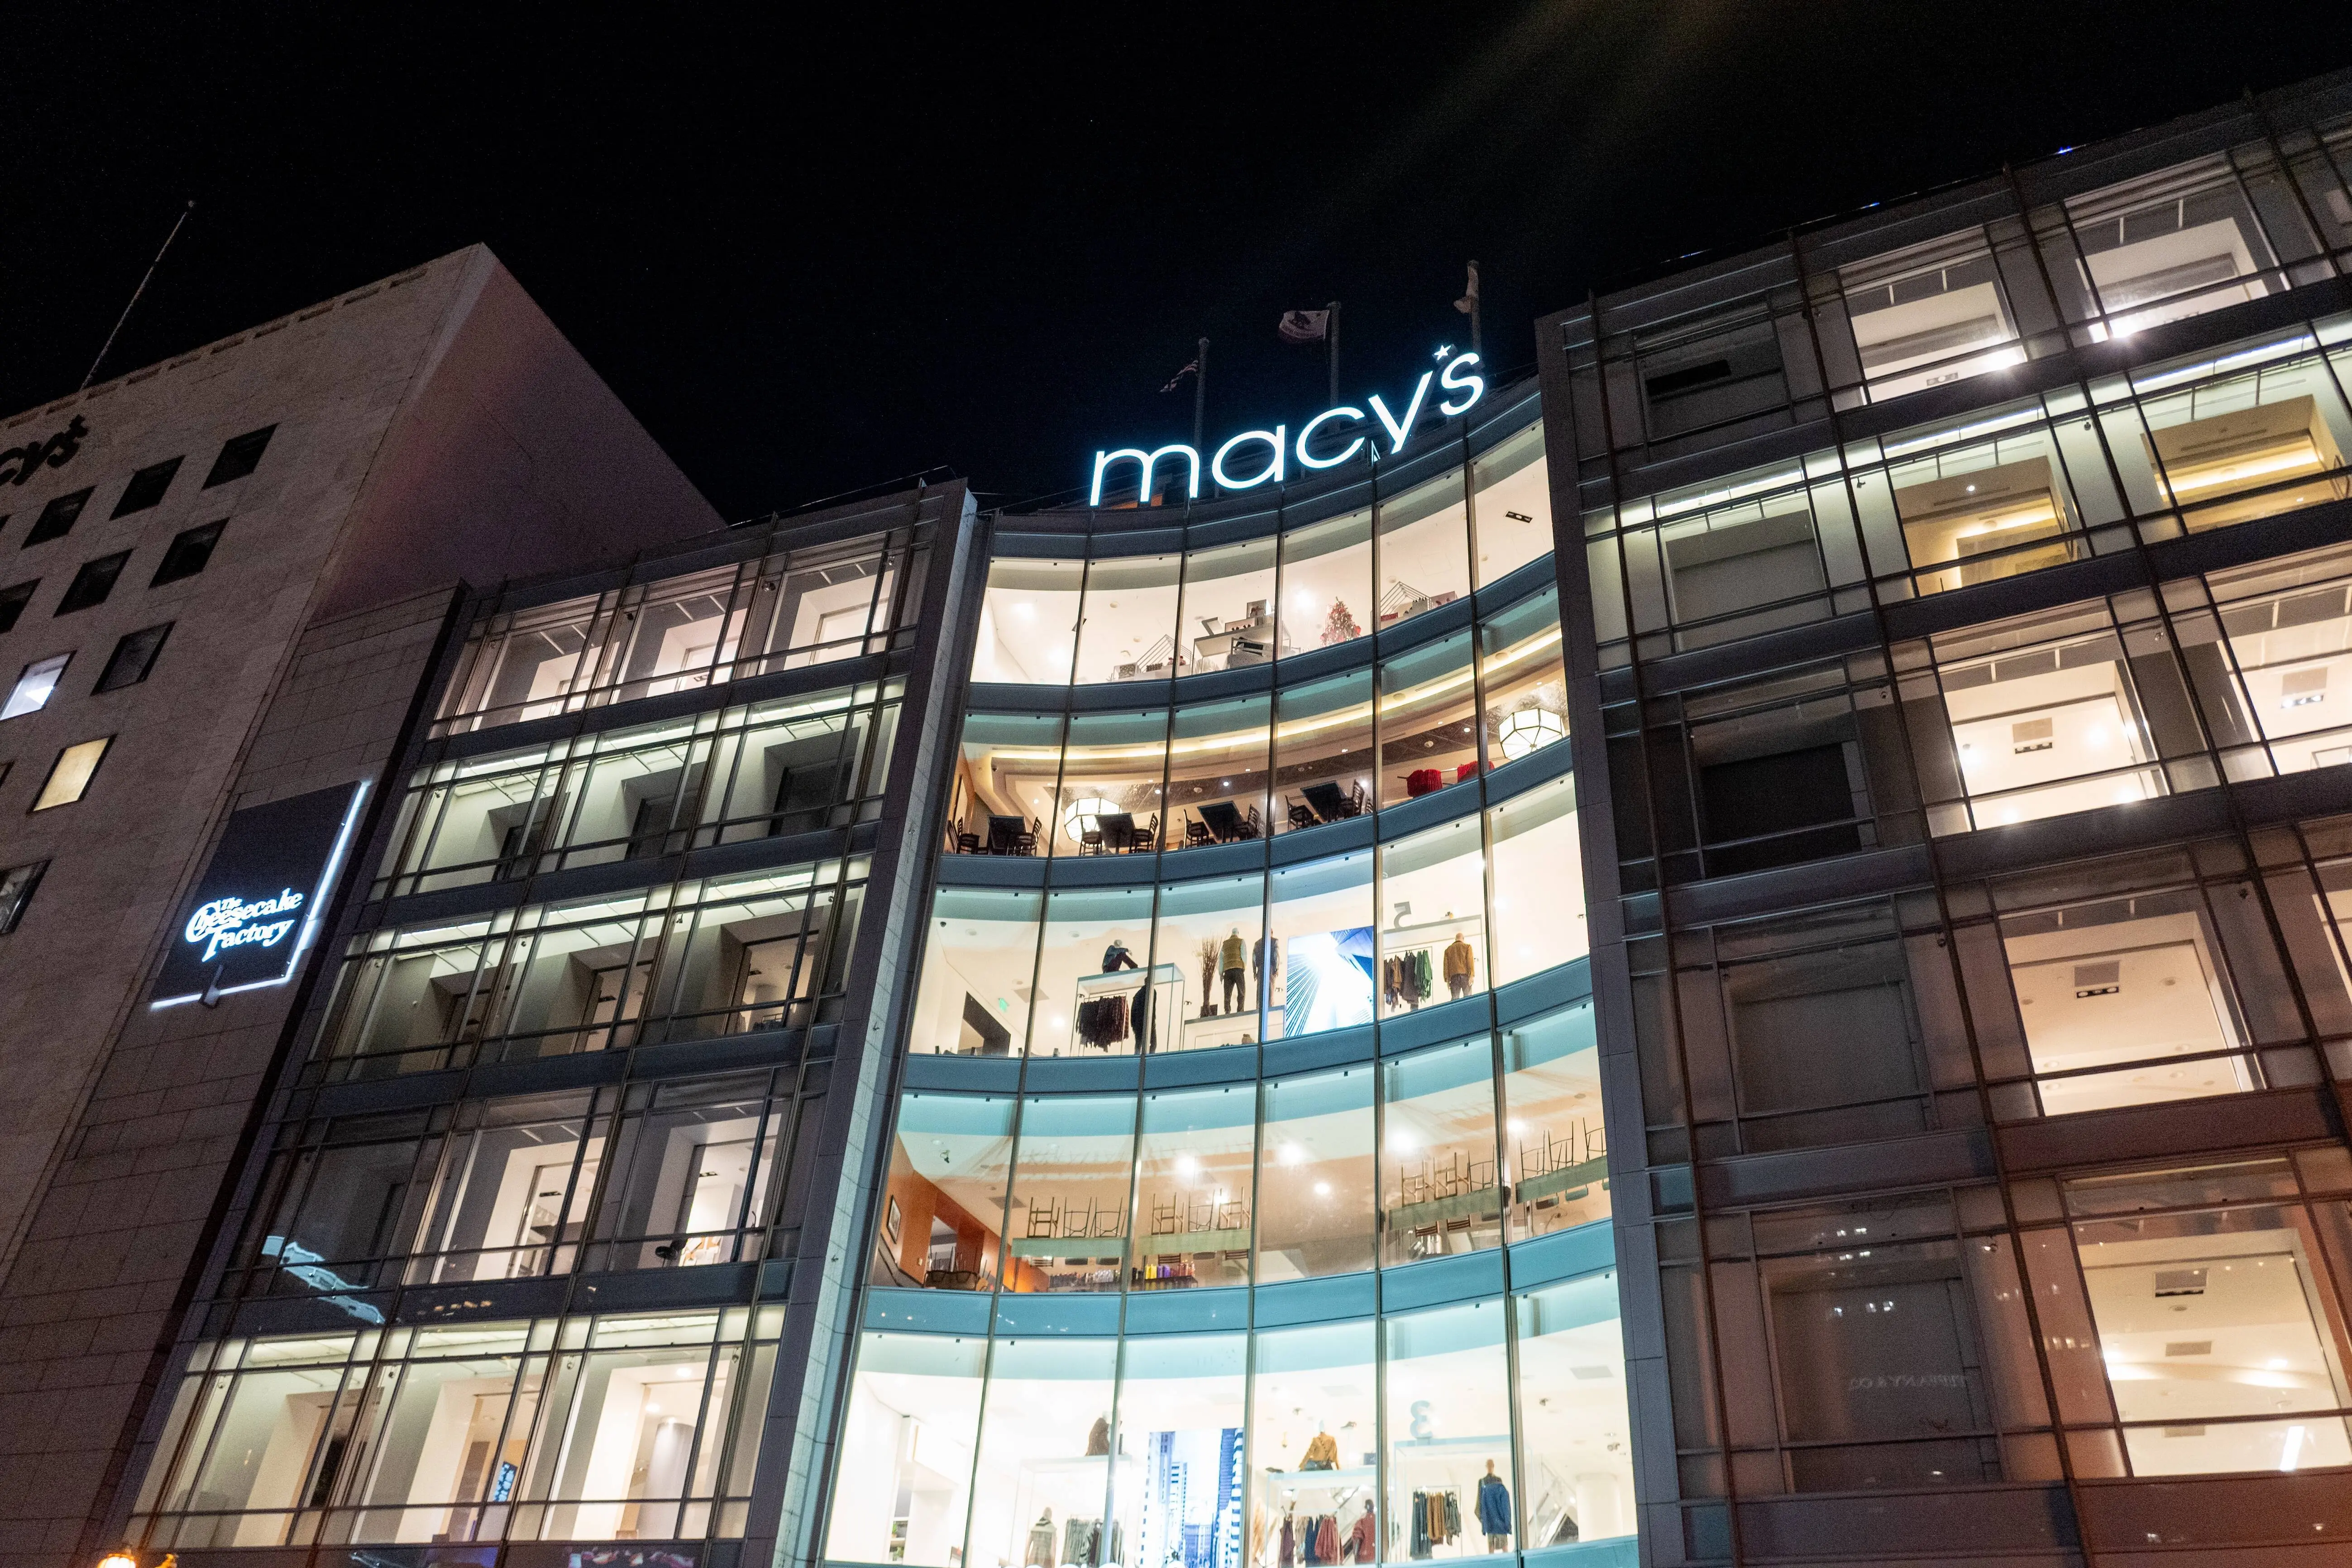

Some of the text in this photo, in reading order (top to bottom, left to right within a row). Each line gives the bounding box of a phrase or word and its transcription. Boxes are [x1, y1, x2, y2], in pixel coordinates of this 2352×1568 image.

[1090, 344, 1484, 507] macy's
[185, 887, 304, 943] Cheesecake
[221, 897, 243, 910] The
[201, 919, 296, 962] Factory
